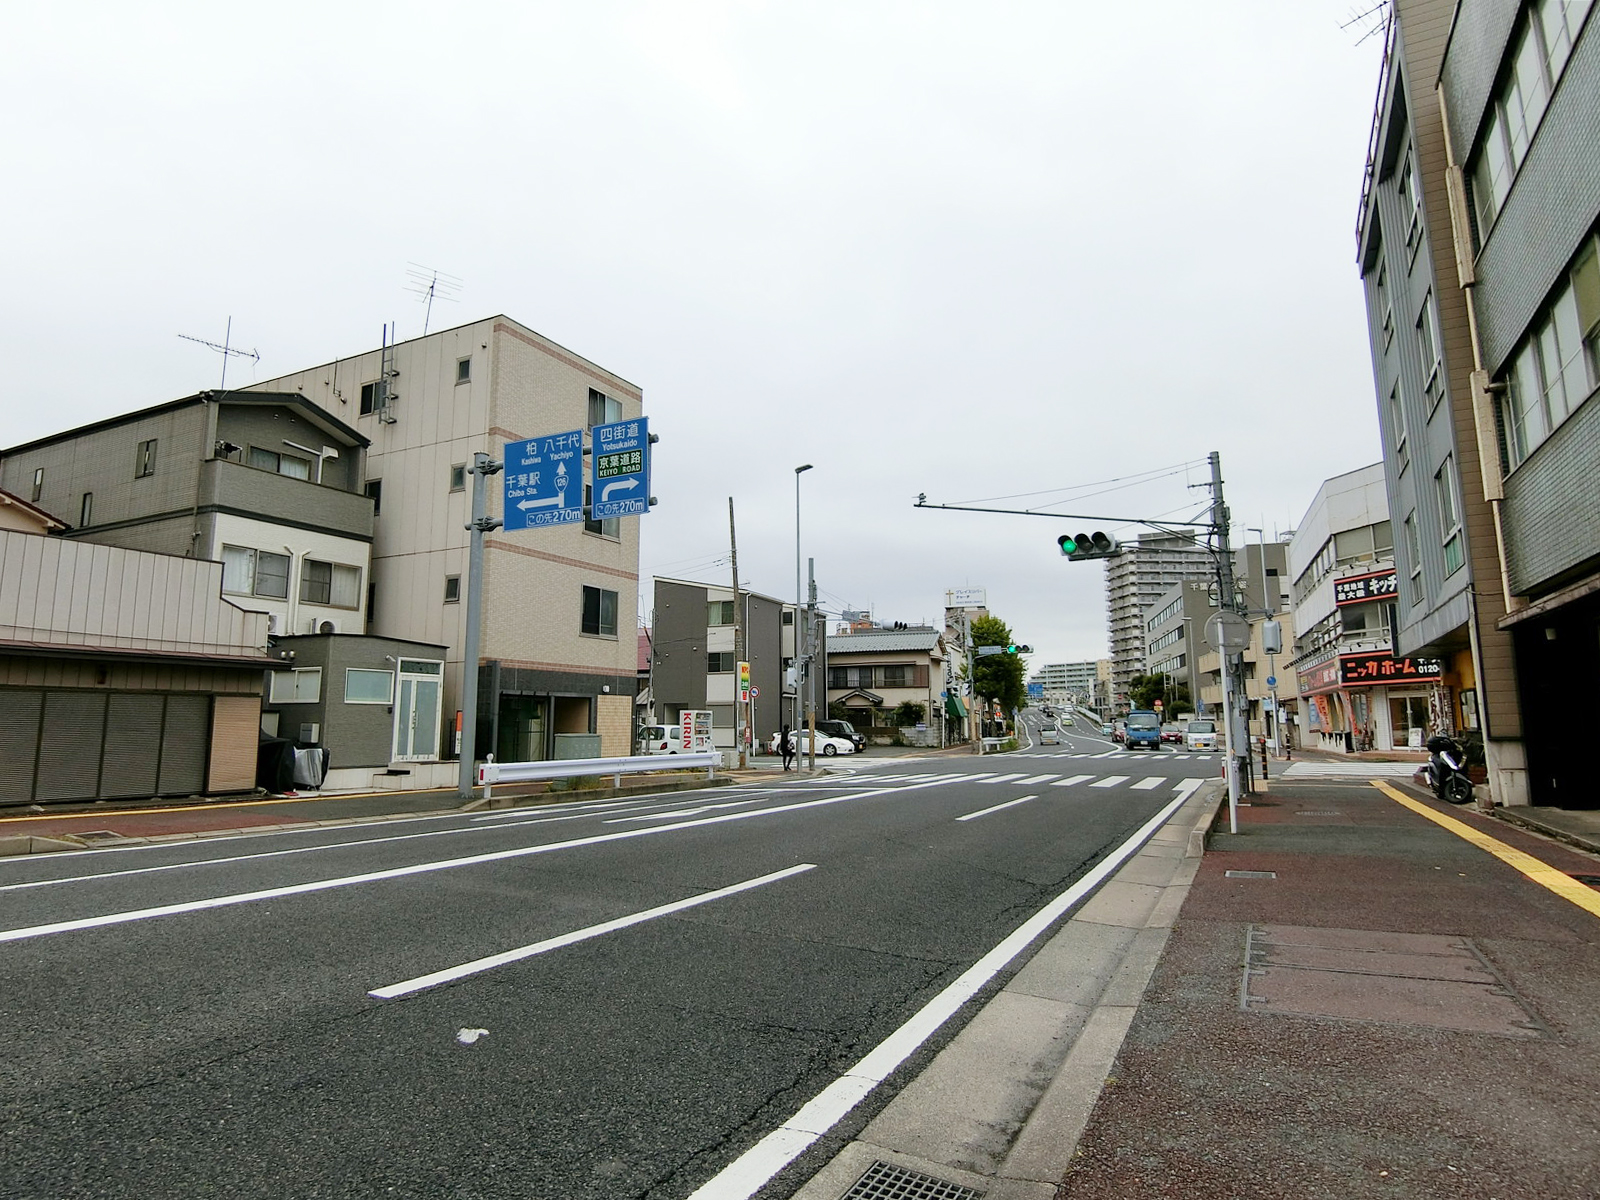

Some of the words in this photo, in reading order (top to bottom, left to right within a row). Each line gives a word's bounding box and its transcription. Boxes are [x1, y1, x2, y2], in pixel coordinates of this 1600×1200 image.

[600, 423, 639, 442] 四街道
[526, 442, 537, 456] 柏
[543, 434, 580, 453] 八千代
[602, 439, 638, 451] Yotsukaido
[521, 456, 542, 466] Kashiwa
[550, 451, 574, 461] Yachiyo
[599, 451, 641, 469] 京葉道路
[599, 468, 618, 477] KEIYO
[622, 464, 641, 473] ROAD
[506, 471, 541, 487] 千葉駅
[557, 478, 566, 486] 126
[507, 489, 525, 498] Chiba
[597, 501, 643, 516] この先270m
[528, 510, 581, 525] この先270m
[1369, 574, 1397, 594] キッチ
[1347, 658, 1416, 678] ニッカホーム
[683, 713, 692, 749] KIRIN
